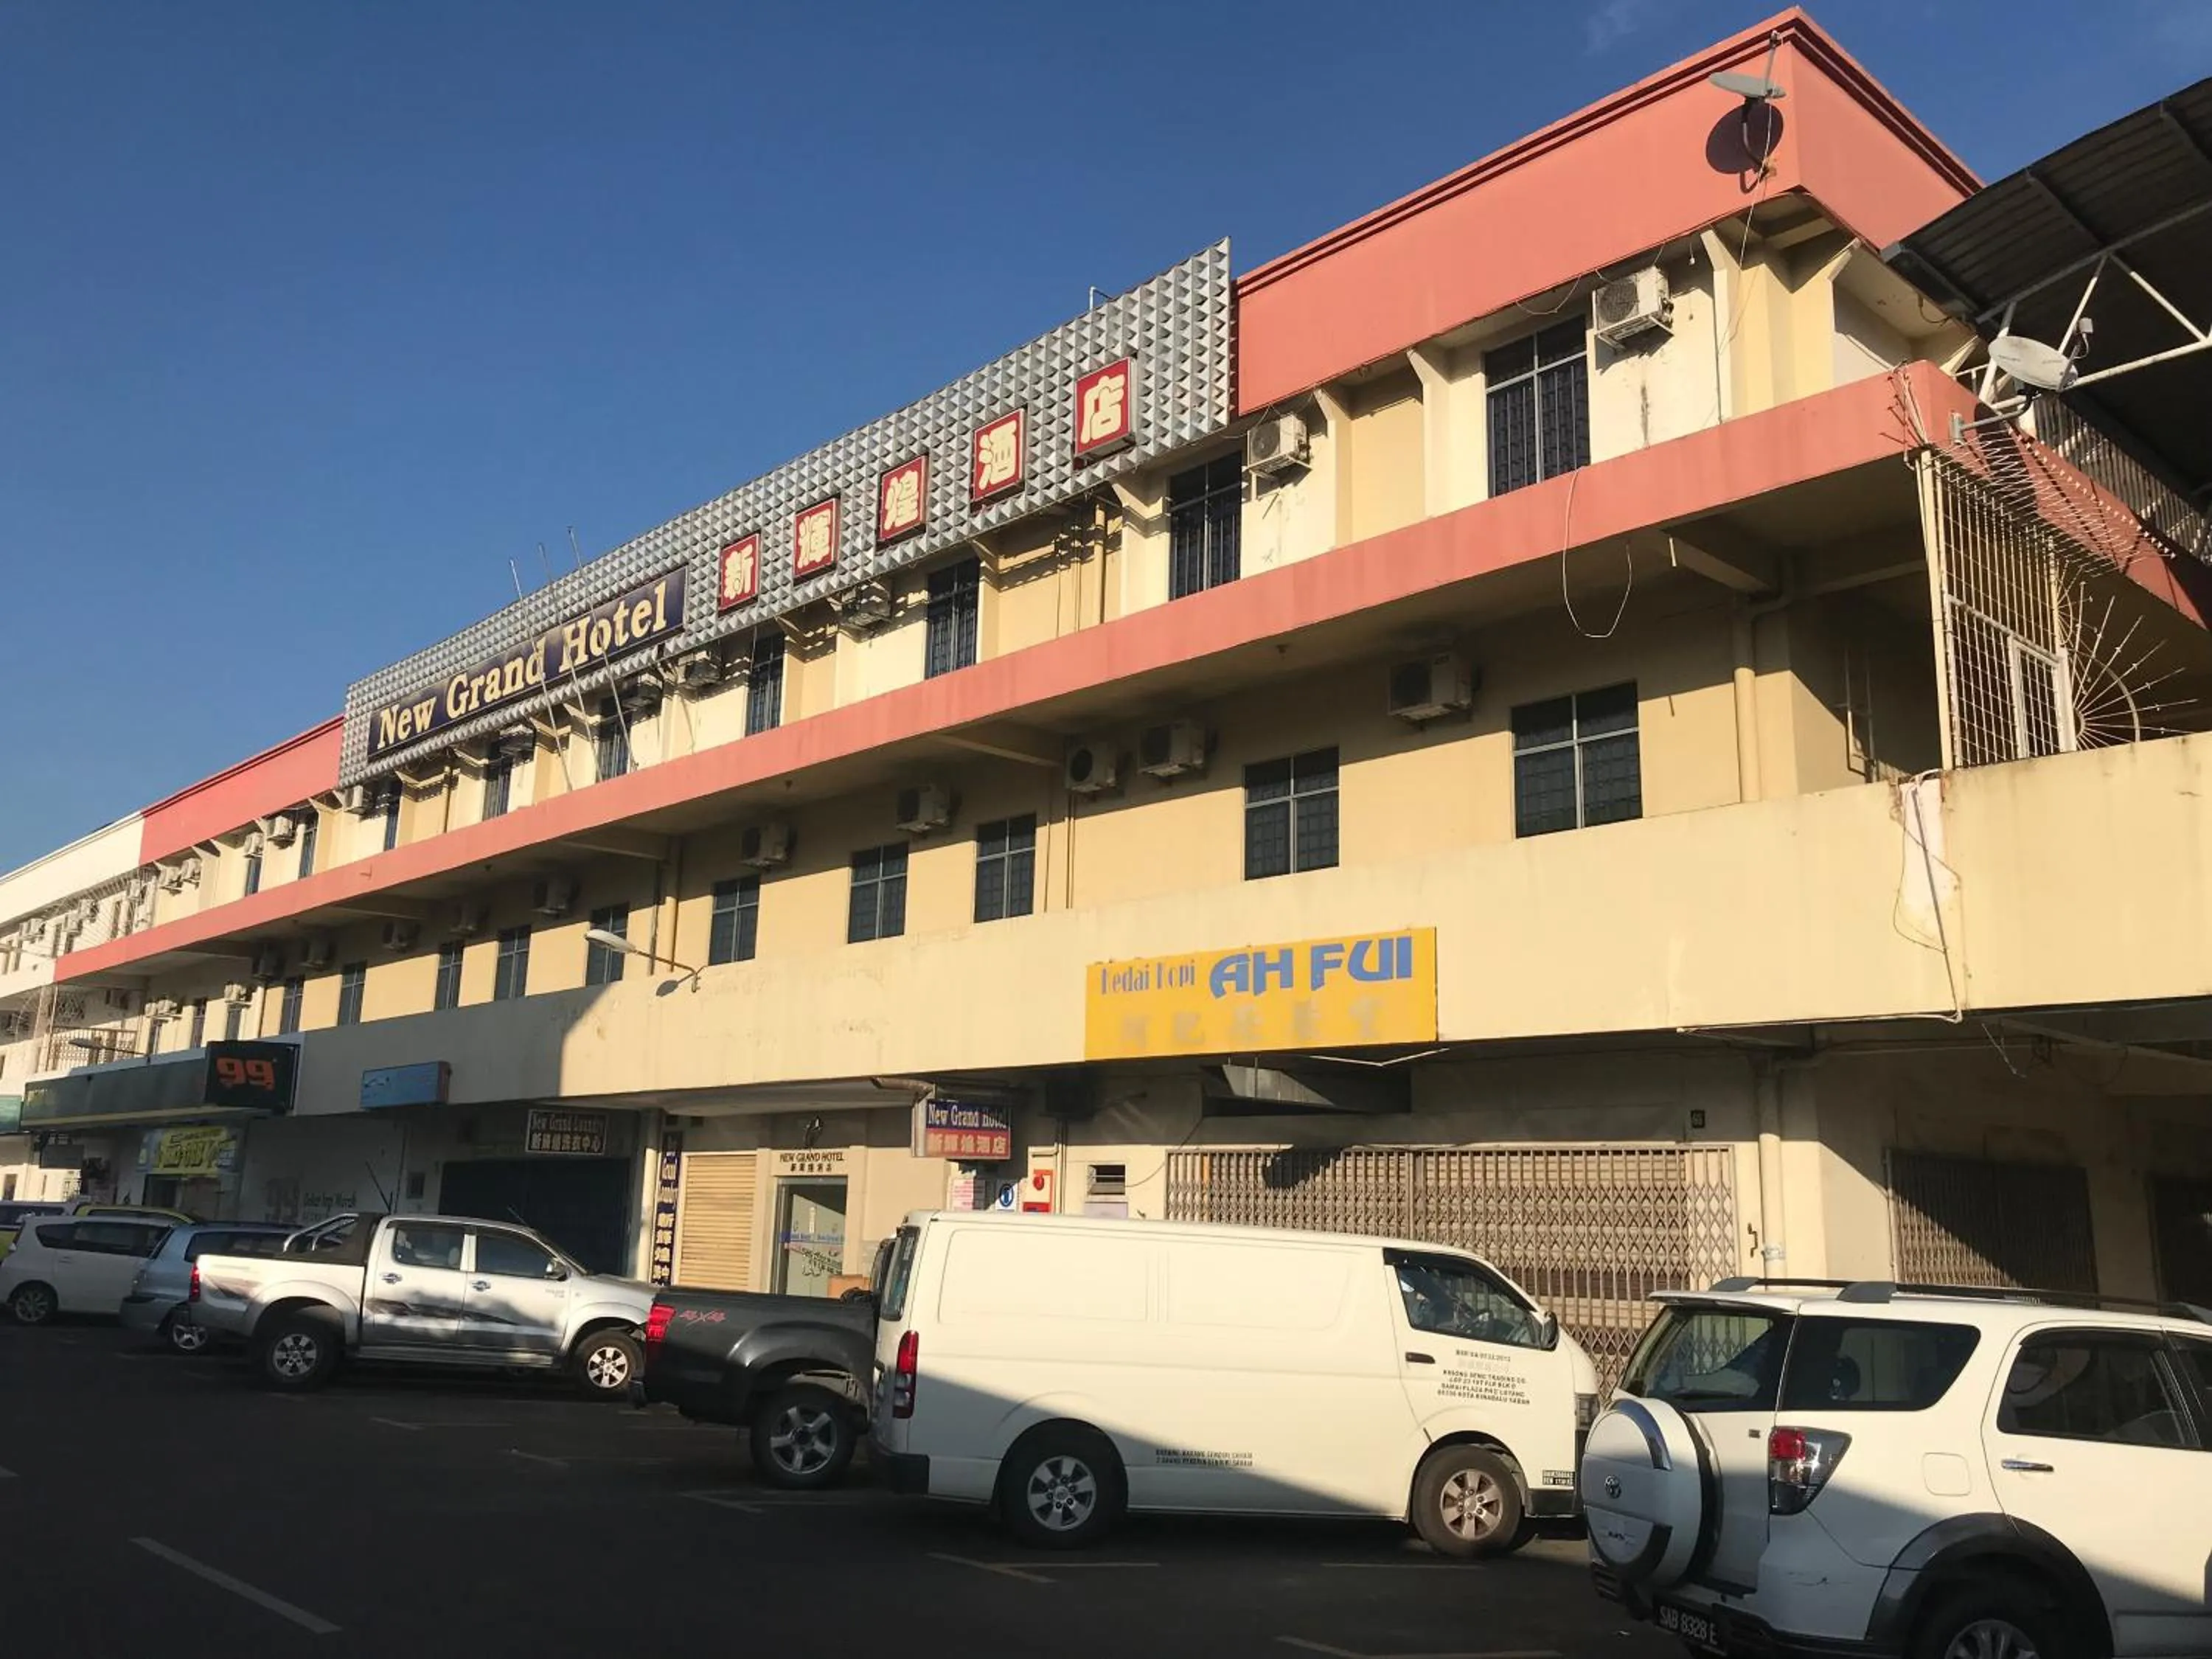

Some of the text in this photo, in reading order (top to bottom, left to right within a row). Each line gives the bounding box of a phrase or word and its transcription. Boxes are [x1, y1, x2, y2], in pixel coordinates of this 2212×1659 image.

[377, 581, 667, 749] New Grand Hotel
[1209, 947, 1293, 998] AH
[1310, 936, 1412, 991] FUI
[216, 1057, 274, 1091] 99
[928, 1104, 948, 1125] New
[950, 1105, 979, 1127] Grand
[780, 1152, 844, 1162] NEW GRAND HOTEL
[1660, 1606, 1719, 1646] SAB 8328 E
